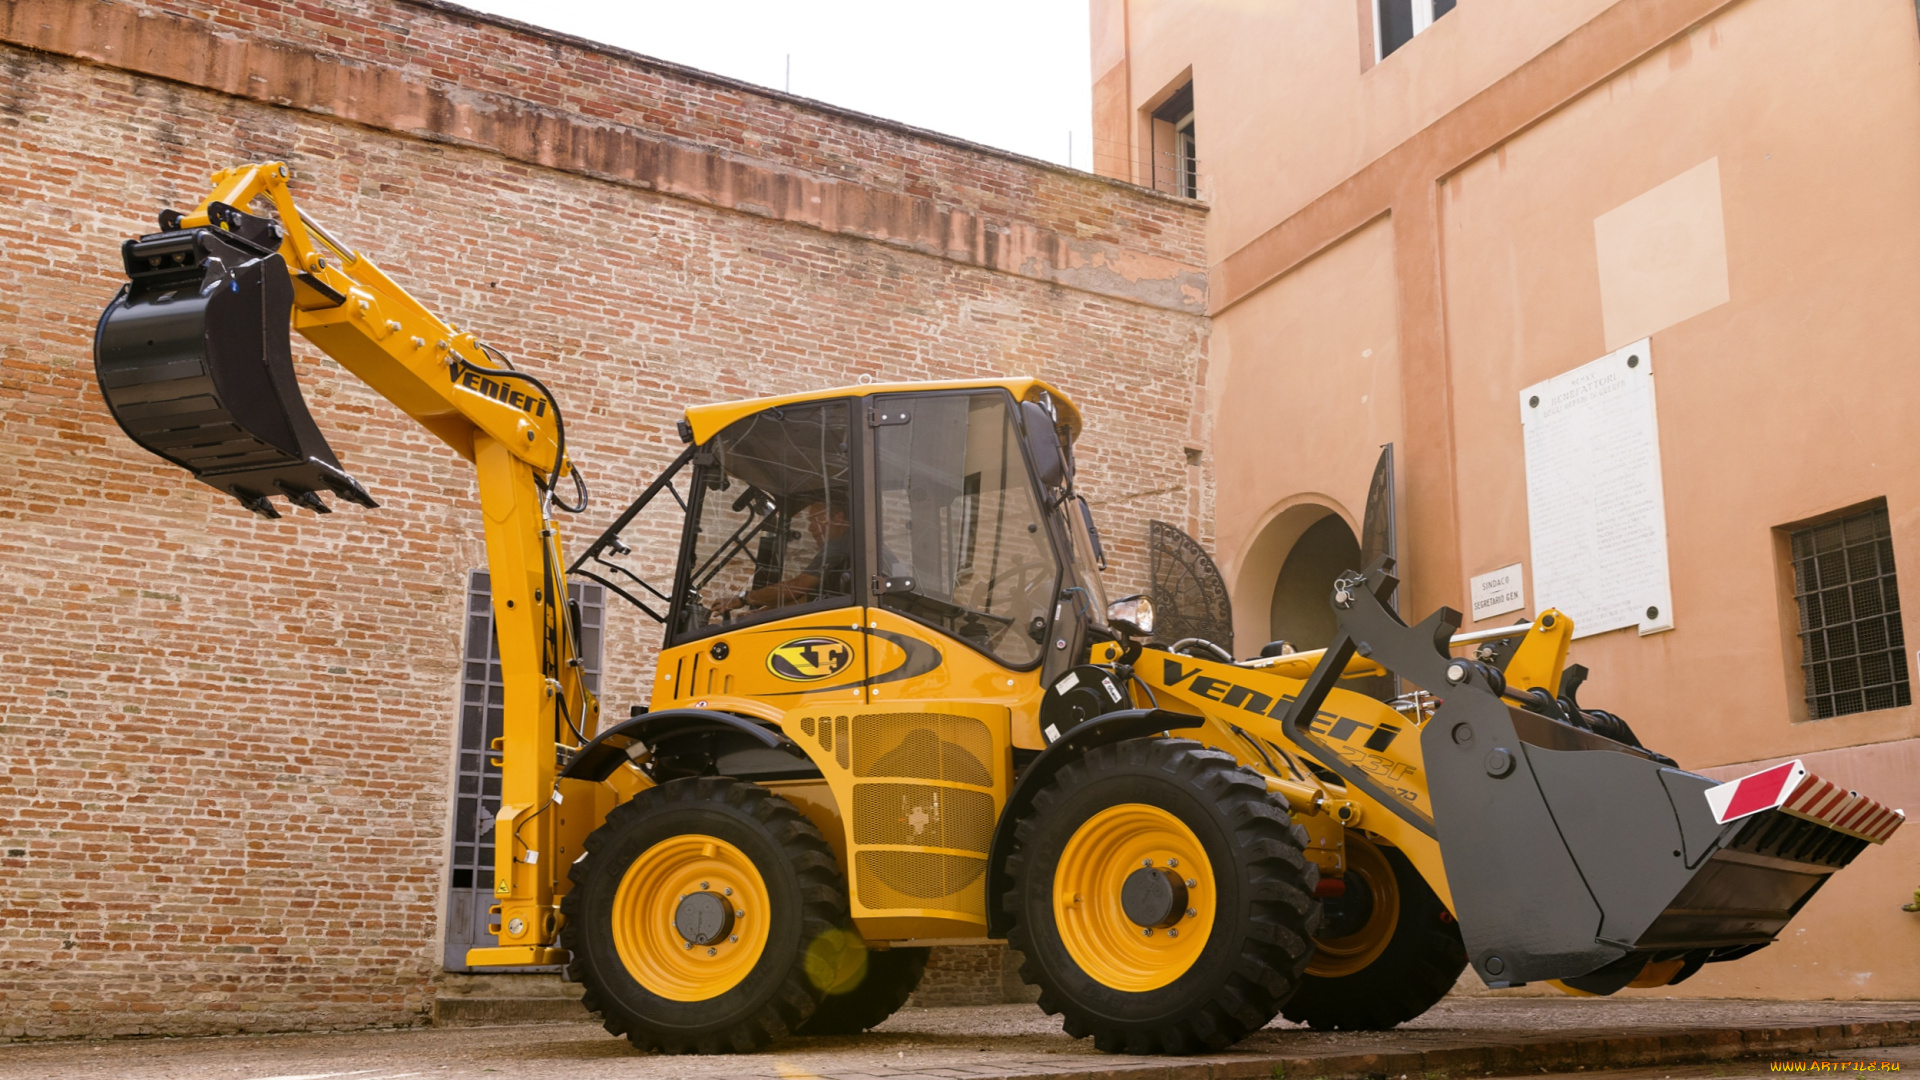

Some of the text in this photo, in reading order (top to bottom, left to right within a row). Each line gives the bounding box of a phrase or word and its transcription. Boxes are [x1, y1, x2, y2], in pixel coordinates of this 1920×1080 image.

[1551, 373, 1617, 406] BENEFATTORI
[1482, 576, 1510, 591] SINDACO
[1474, 591, 1519, 611] SEGRETARIO GEN
